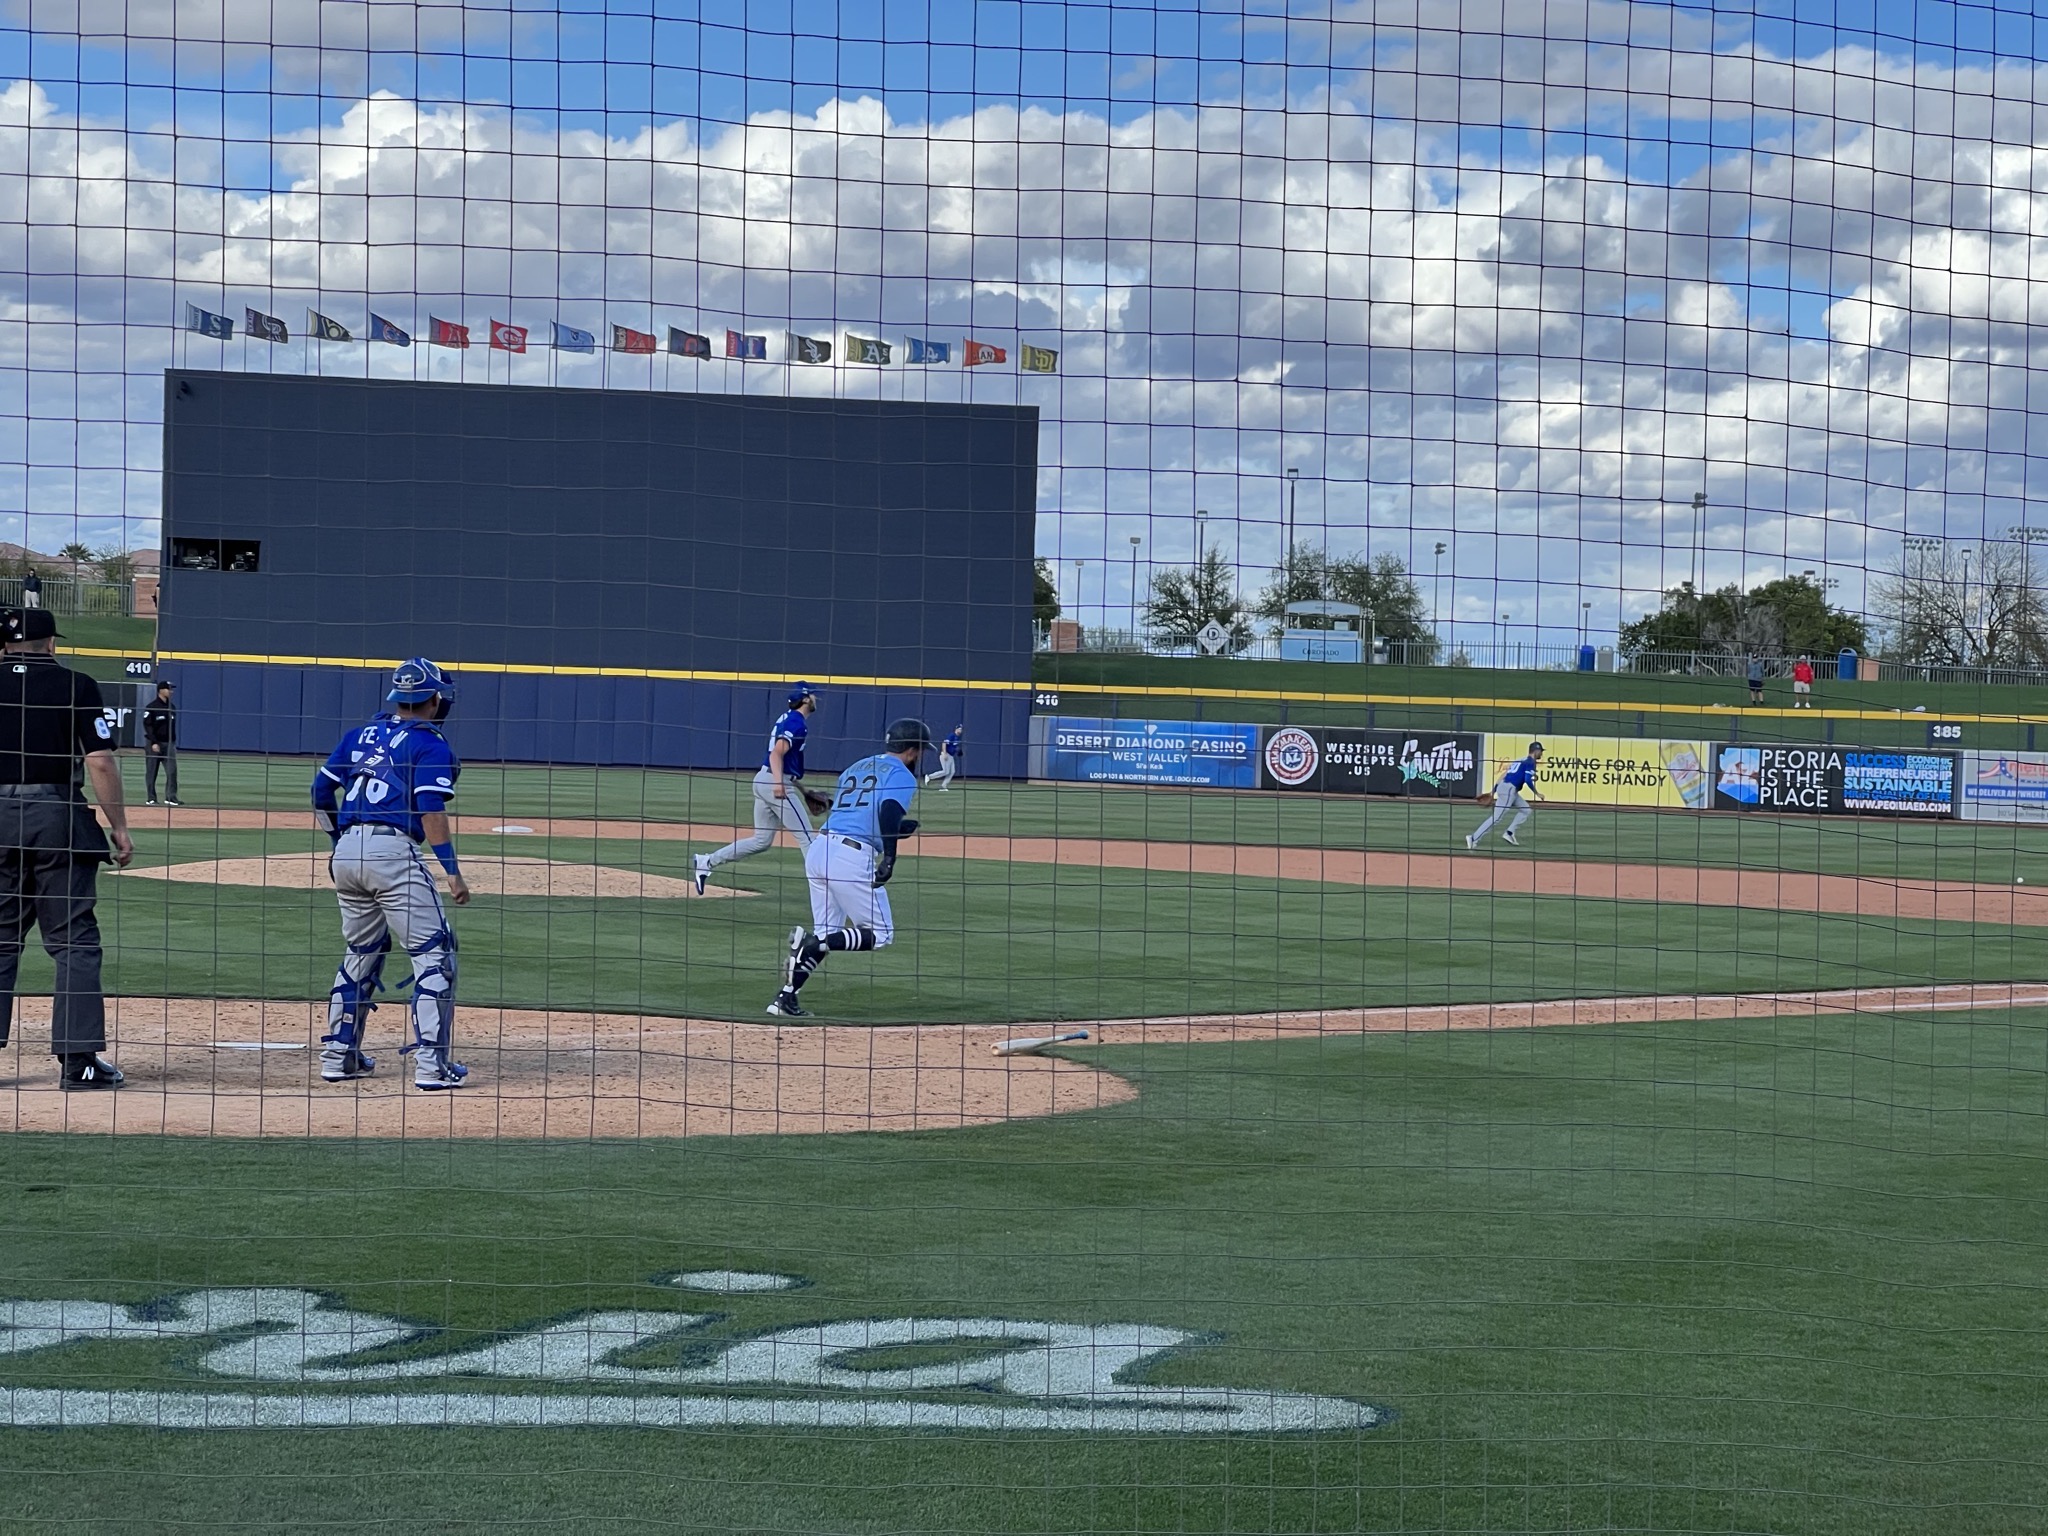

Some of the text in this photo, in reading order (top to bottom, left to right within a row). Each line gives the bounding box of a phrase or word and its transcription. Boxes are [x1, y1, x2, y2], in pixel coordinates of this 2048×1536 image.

[126, 662, 151, 674] 410
[1932, 725, 1962, 738] 385
[1057, 734, 1247, 754] DESERT DIAMOND CASINO
[1326, 743, 1395, 756] WESTSIDE
[1112, 751, 1188, 763] WEST VALLEY
[1325, 754, 1395, 767] CONCEPTS
[1547, 757, 1601, 771] SWING
[1606, 758, 1635, 772] FOR
[1641, 760, 1651, 772] A
[1761, 750, 1842, 770] PEORIA
[1845, 753, 1906, 769] SUCCESS
[1603, 772, 1667, 787] SHANDY
[1760, 769, 1825, 789] IS THE
[1844, 767, 1953, 781] ENTREPRENEURSHIP
[837, 775, 878, 808] 22
[1844, 777, 1952, 793] SUSTAINABLE
[1760, 788, 1829, 808] PLACE
[1844, 799, 1952, 813] WWW.PEORIAED.COM
